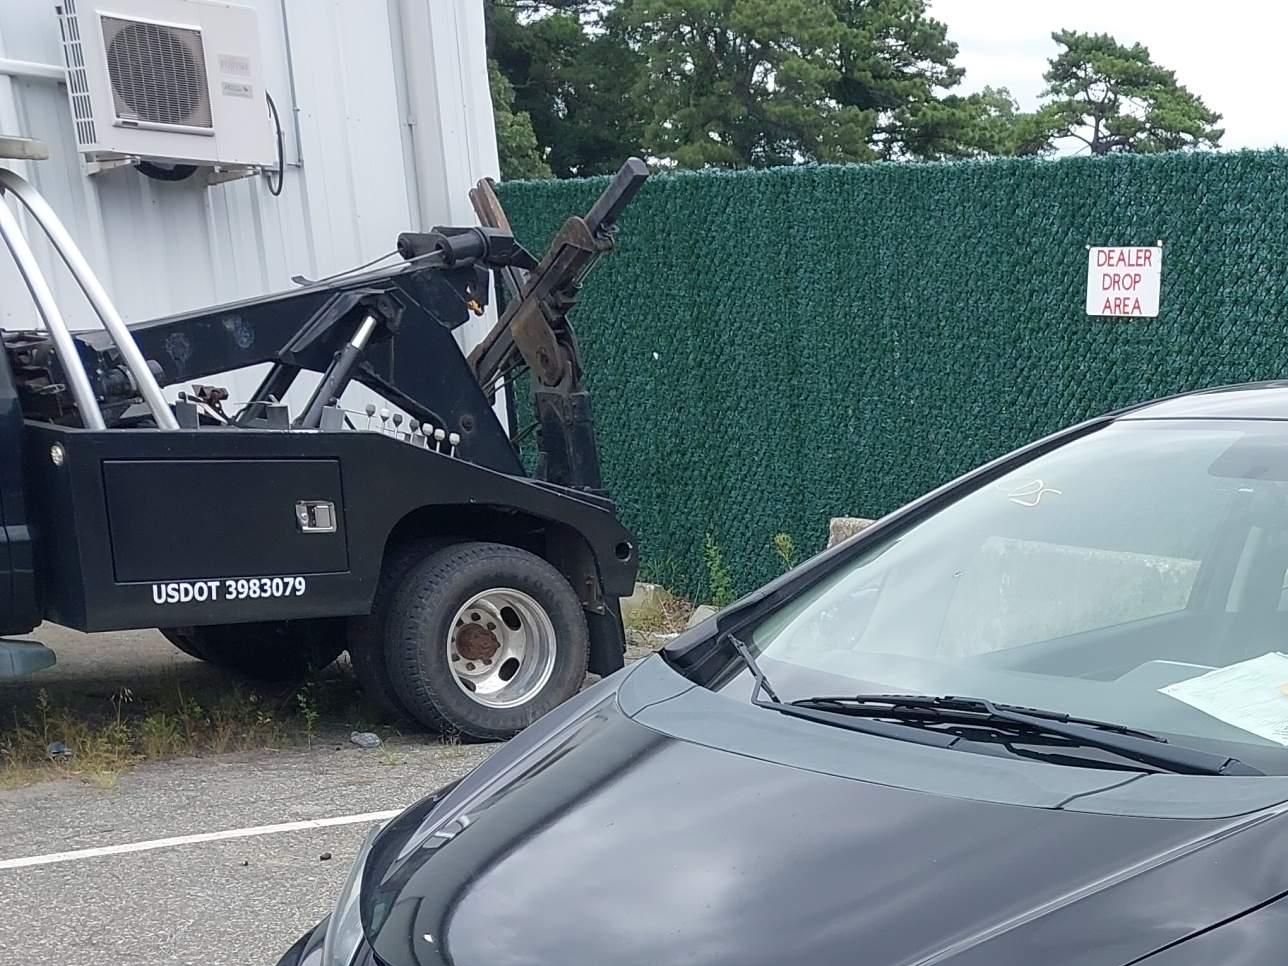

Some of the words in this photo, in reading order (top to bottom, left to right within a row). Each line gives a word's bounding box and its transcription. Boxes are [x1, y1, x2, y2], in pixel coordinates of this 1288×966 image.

[1096, 249, 1152, 267] DEALER
[1101, 273, 1142, 291] DROP
[1101, 297, 1142, 315] AREA
[152, 581, 220, 604] USDOT
[225, 577, 306, 600] 3983079
